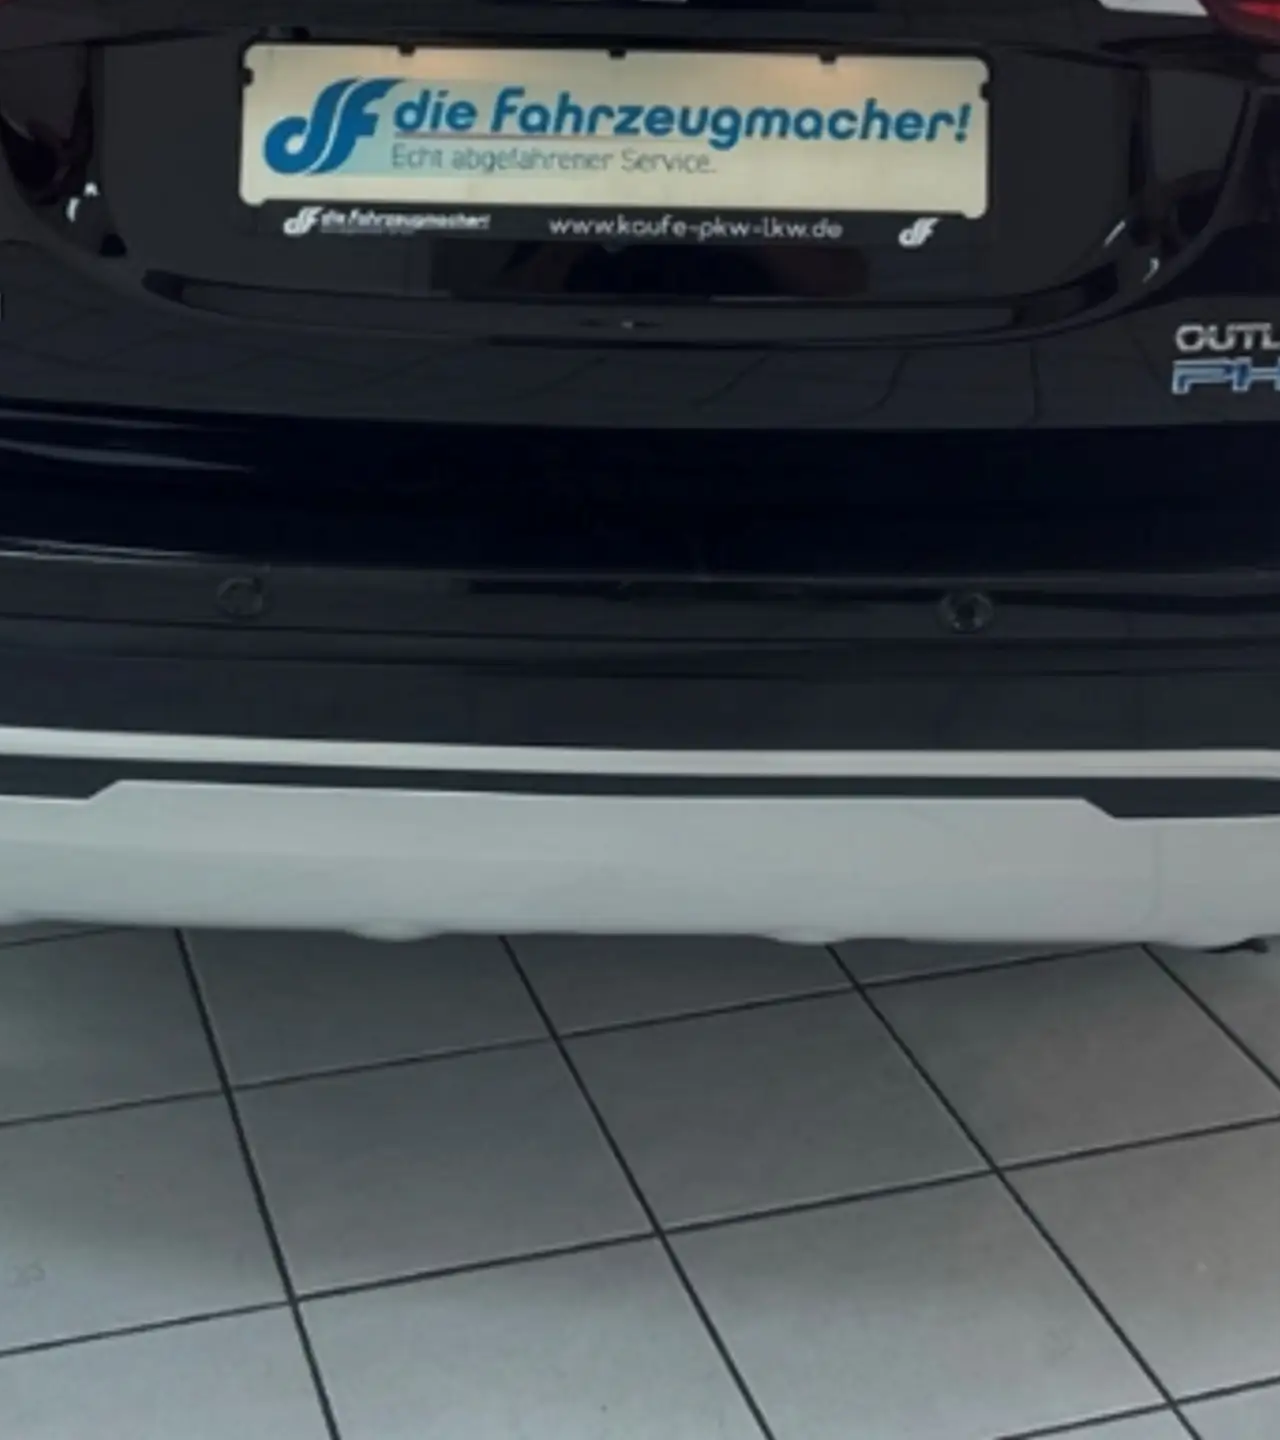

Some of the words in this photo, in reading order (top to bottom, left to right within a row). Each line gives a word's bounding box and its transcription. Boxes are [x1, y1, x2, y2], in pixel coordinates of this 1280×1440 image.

[393, 89, 478, 132] die
[490, 87, 972, 151] Fahrzeugmacher!
[392, 144, 442, 169] Echt
[451, 145, 613, 173] abgefahrener
[621, 148, 717, 174] Service.
[548, 213, 843, 241] www.kaufe-pkw-lkw.de
